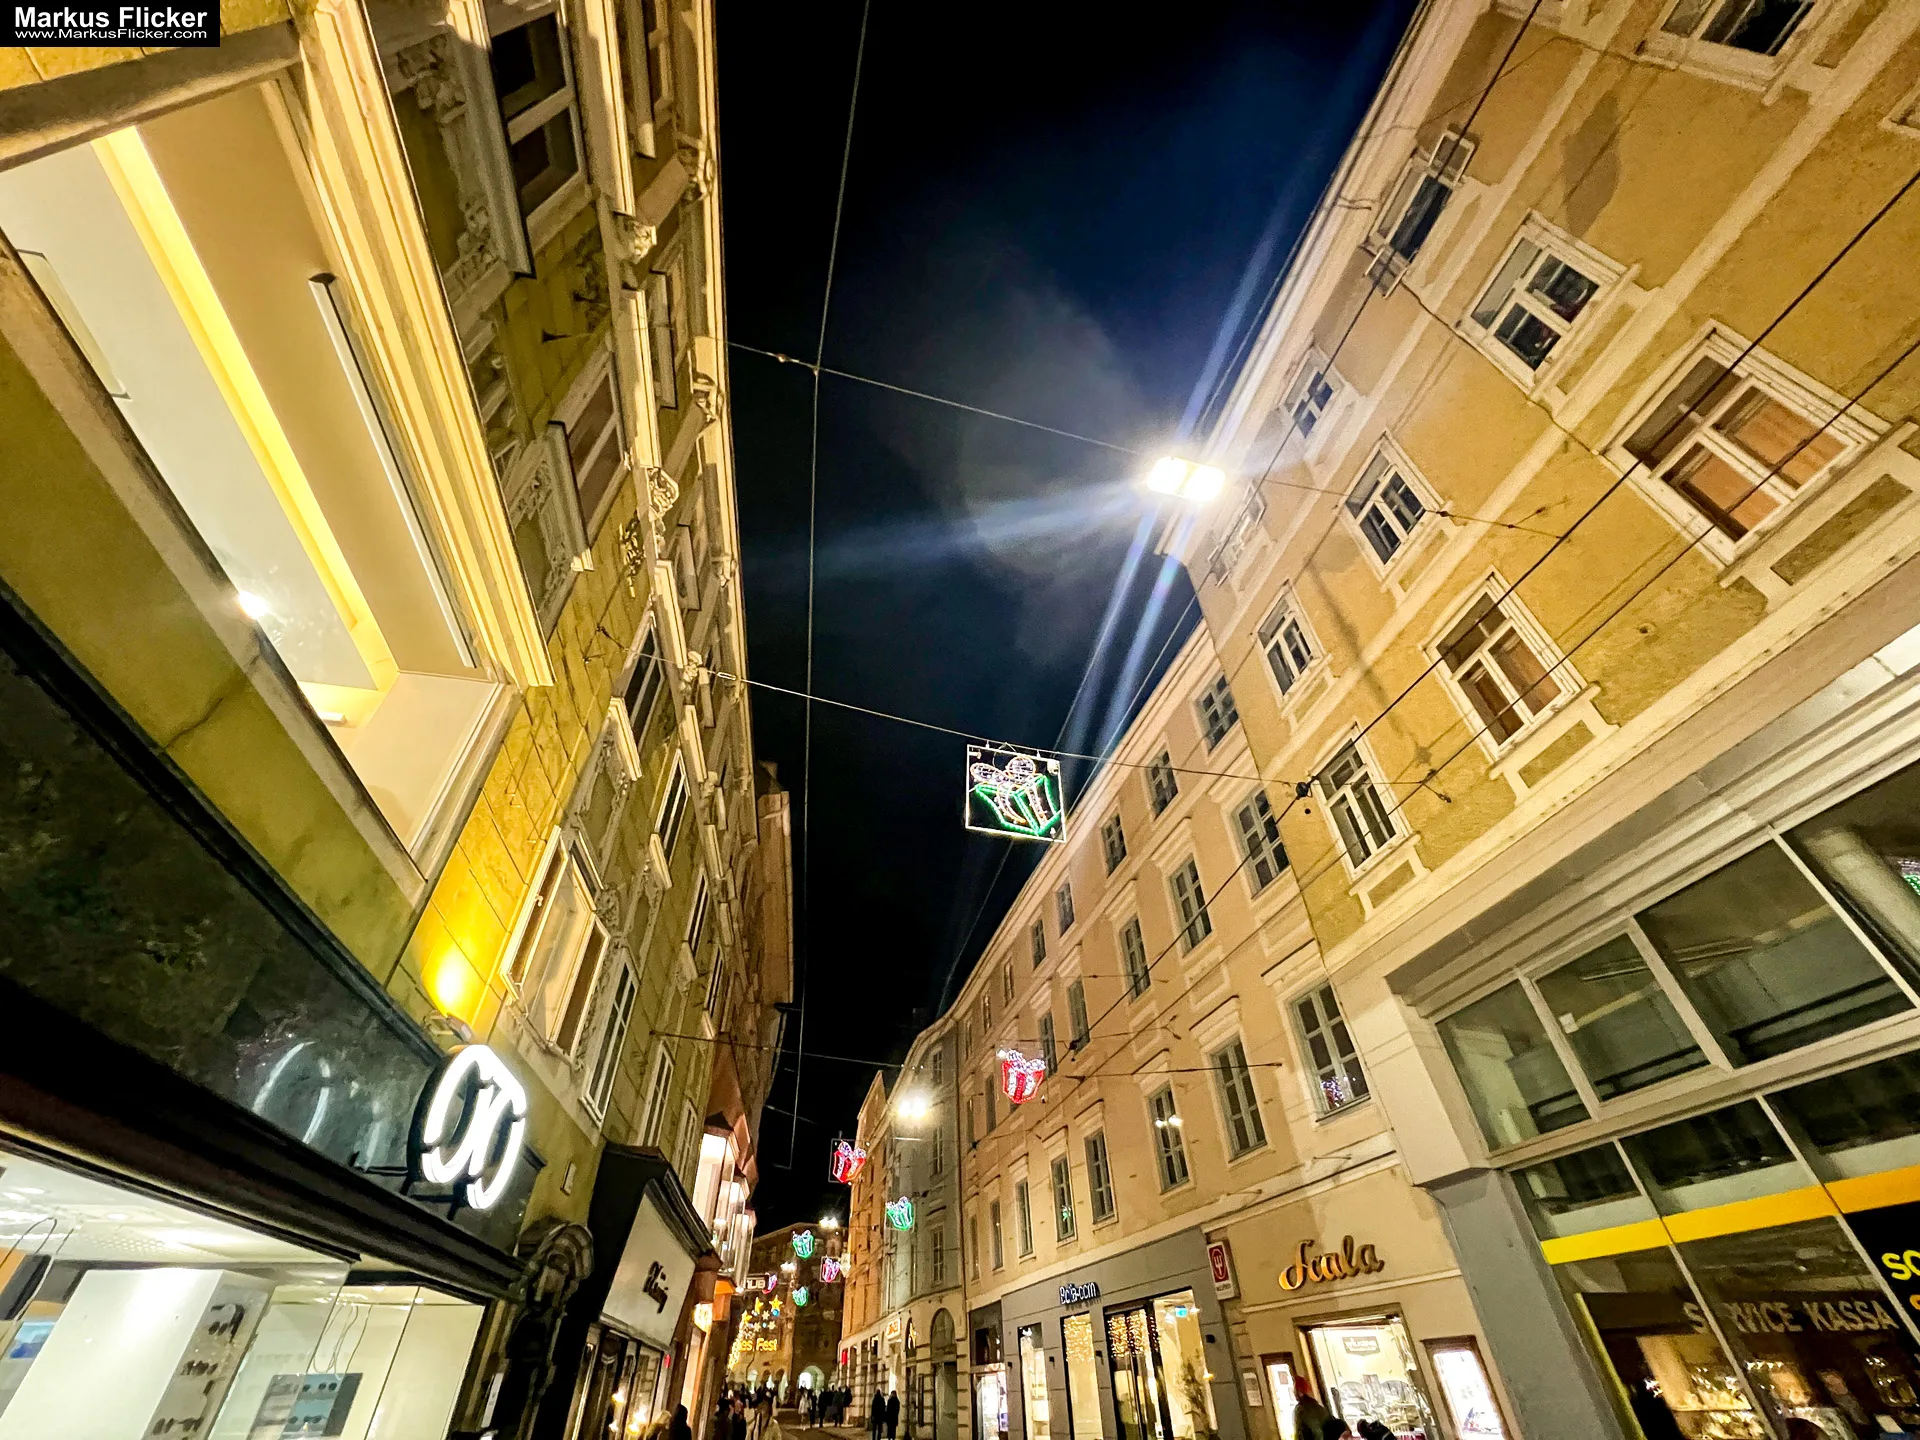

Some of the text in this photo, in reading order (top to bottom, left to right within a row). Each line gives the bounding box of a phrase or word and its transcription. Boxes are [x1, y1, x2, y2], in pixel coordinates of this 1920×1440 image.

[1279, 1235, 1385, 1291] Scala
[1801, 1299, 1900, 1333] KASSA
[755, 1337, 778, 1352] Fest
